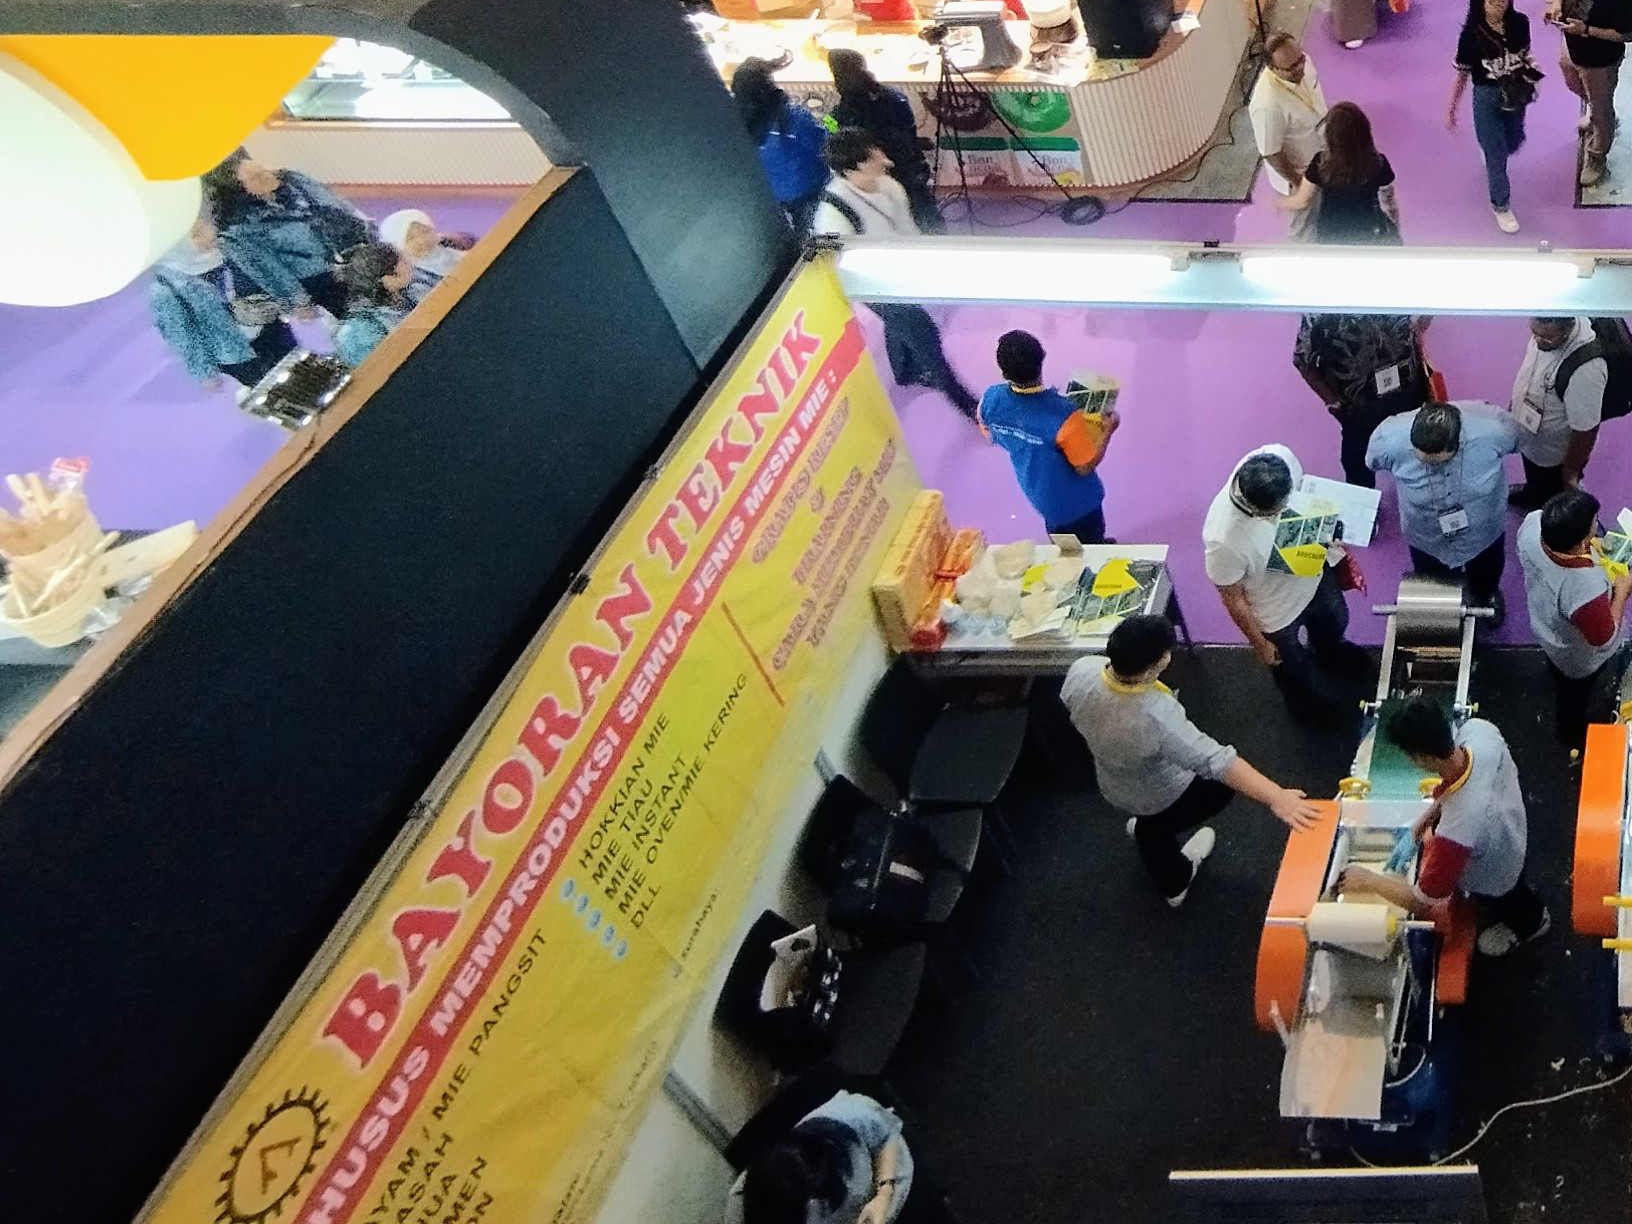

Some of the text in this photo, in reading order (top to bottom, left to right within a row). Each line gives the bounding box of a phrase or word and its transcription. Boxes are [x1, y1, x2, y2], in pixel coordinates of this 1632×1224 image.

[322, 310, 821, 1069] BAYORAN TEKNIK
[430, 726, 622, 1038] MEMPRODUKSI
[618, 608, 695, 726] SEMUA
[692, 515, 746, 606] JENIS
[743, 428, 802, 517] MESIN
[796, 380, 830, 429] MIE
[577, 711, 671, 871] HOKKIAN MIE
[591, 778, 655, 887] MIE TIAU
[603, 752, 688, 901] MIE INSTANT
[617, 672, 749, 916] MIE OVEN/MIE KERING
[629, 883, 663, 930] DLL
[432, 1062, 471, 1121] MIE
[468, 928, 548, 1057] PANGSIT
[418, 1173, 459, 1224] UA
